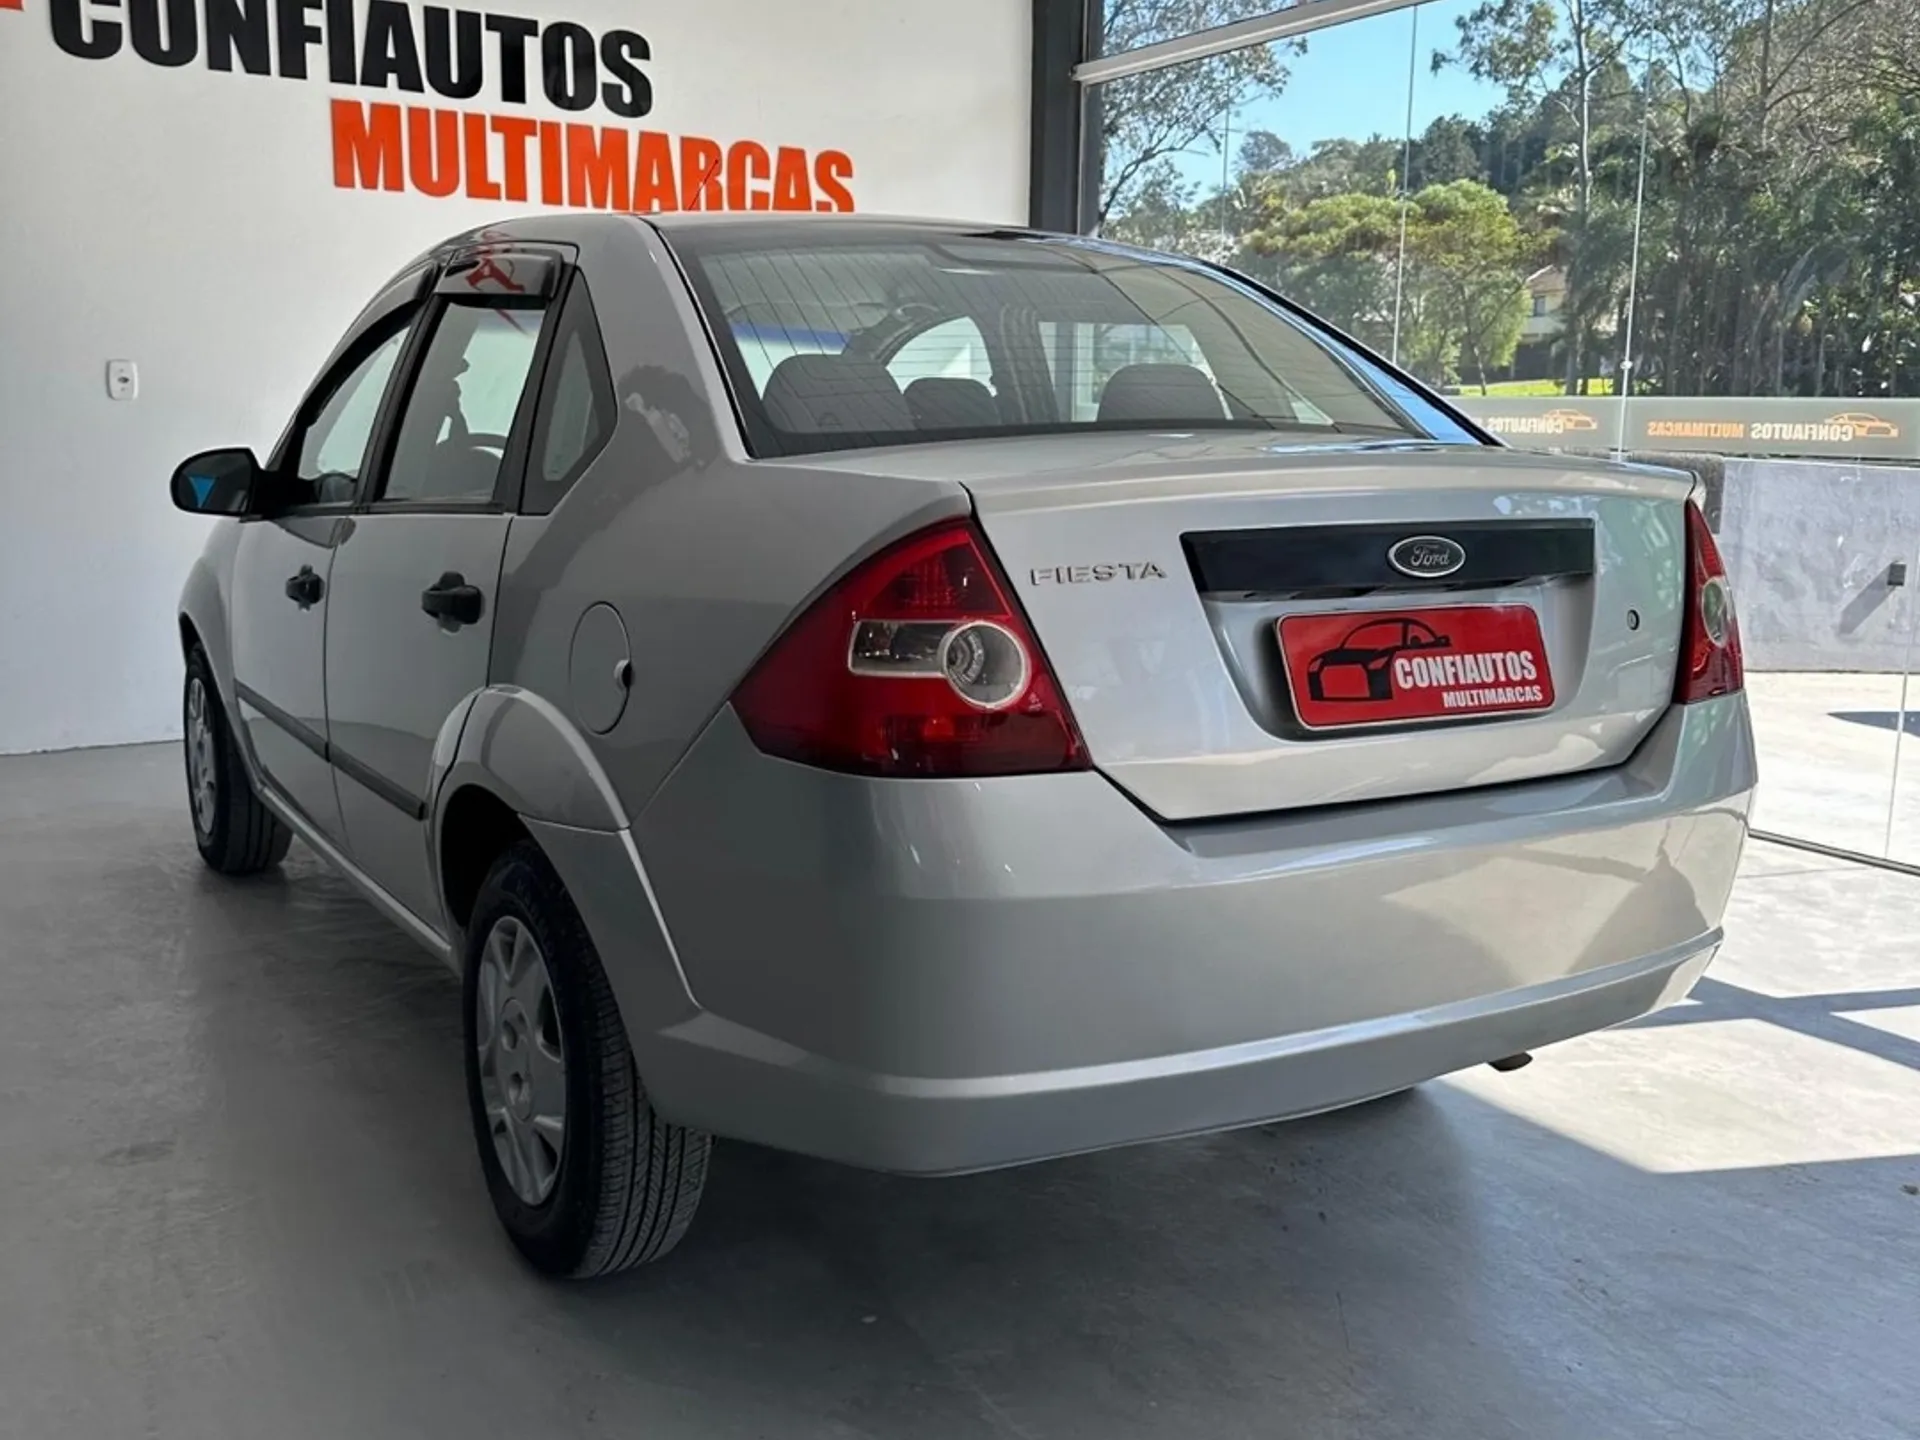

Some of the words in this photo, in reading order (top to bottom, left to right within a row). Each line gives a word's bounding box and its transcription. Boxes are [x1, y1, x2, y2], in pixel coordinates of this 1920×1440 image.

[50, 0, 653, 118] CONFIAUTOS
[330, 98, 855, 212] MULTIMARCAS
[1411, 544, 1450, 566] Ford
[1030, 562, 1167, 585] FIESTA
[1395, 651, 1537, 689] CONFIAUTOS
[1442, 685, 1543, 708] MULTIMARCAS
